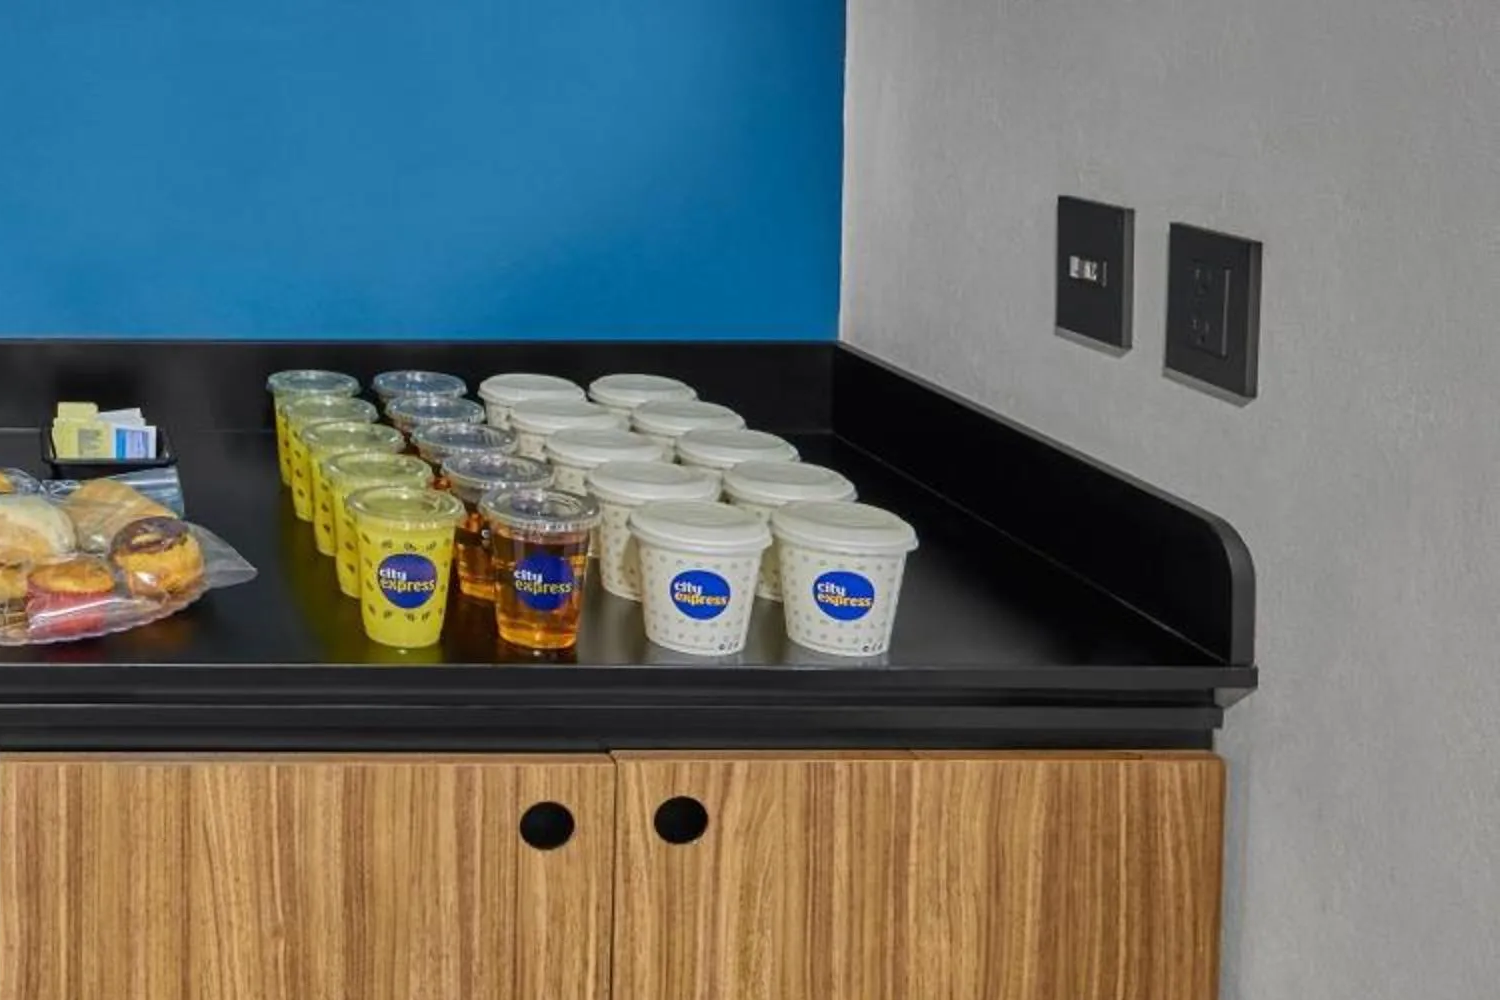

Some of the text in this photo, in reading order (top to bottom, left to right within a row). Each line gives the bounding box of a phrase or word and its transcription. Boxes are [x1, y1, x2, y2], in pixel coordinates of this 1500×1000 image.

[380, 567, 407, 583] city
[513, 569, 543, 583] city
[380, 579, 436, 594] express
[515, 580, 572, 596] express
[674, 581, 703, 595] city
[817, 582, 846, 597] city
[675, 591, 728, 606] express
[817, 593, 872, 607] express
